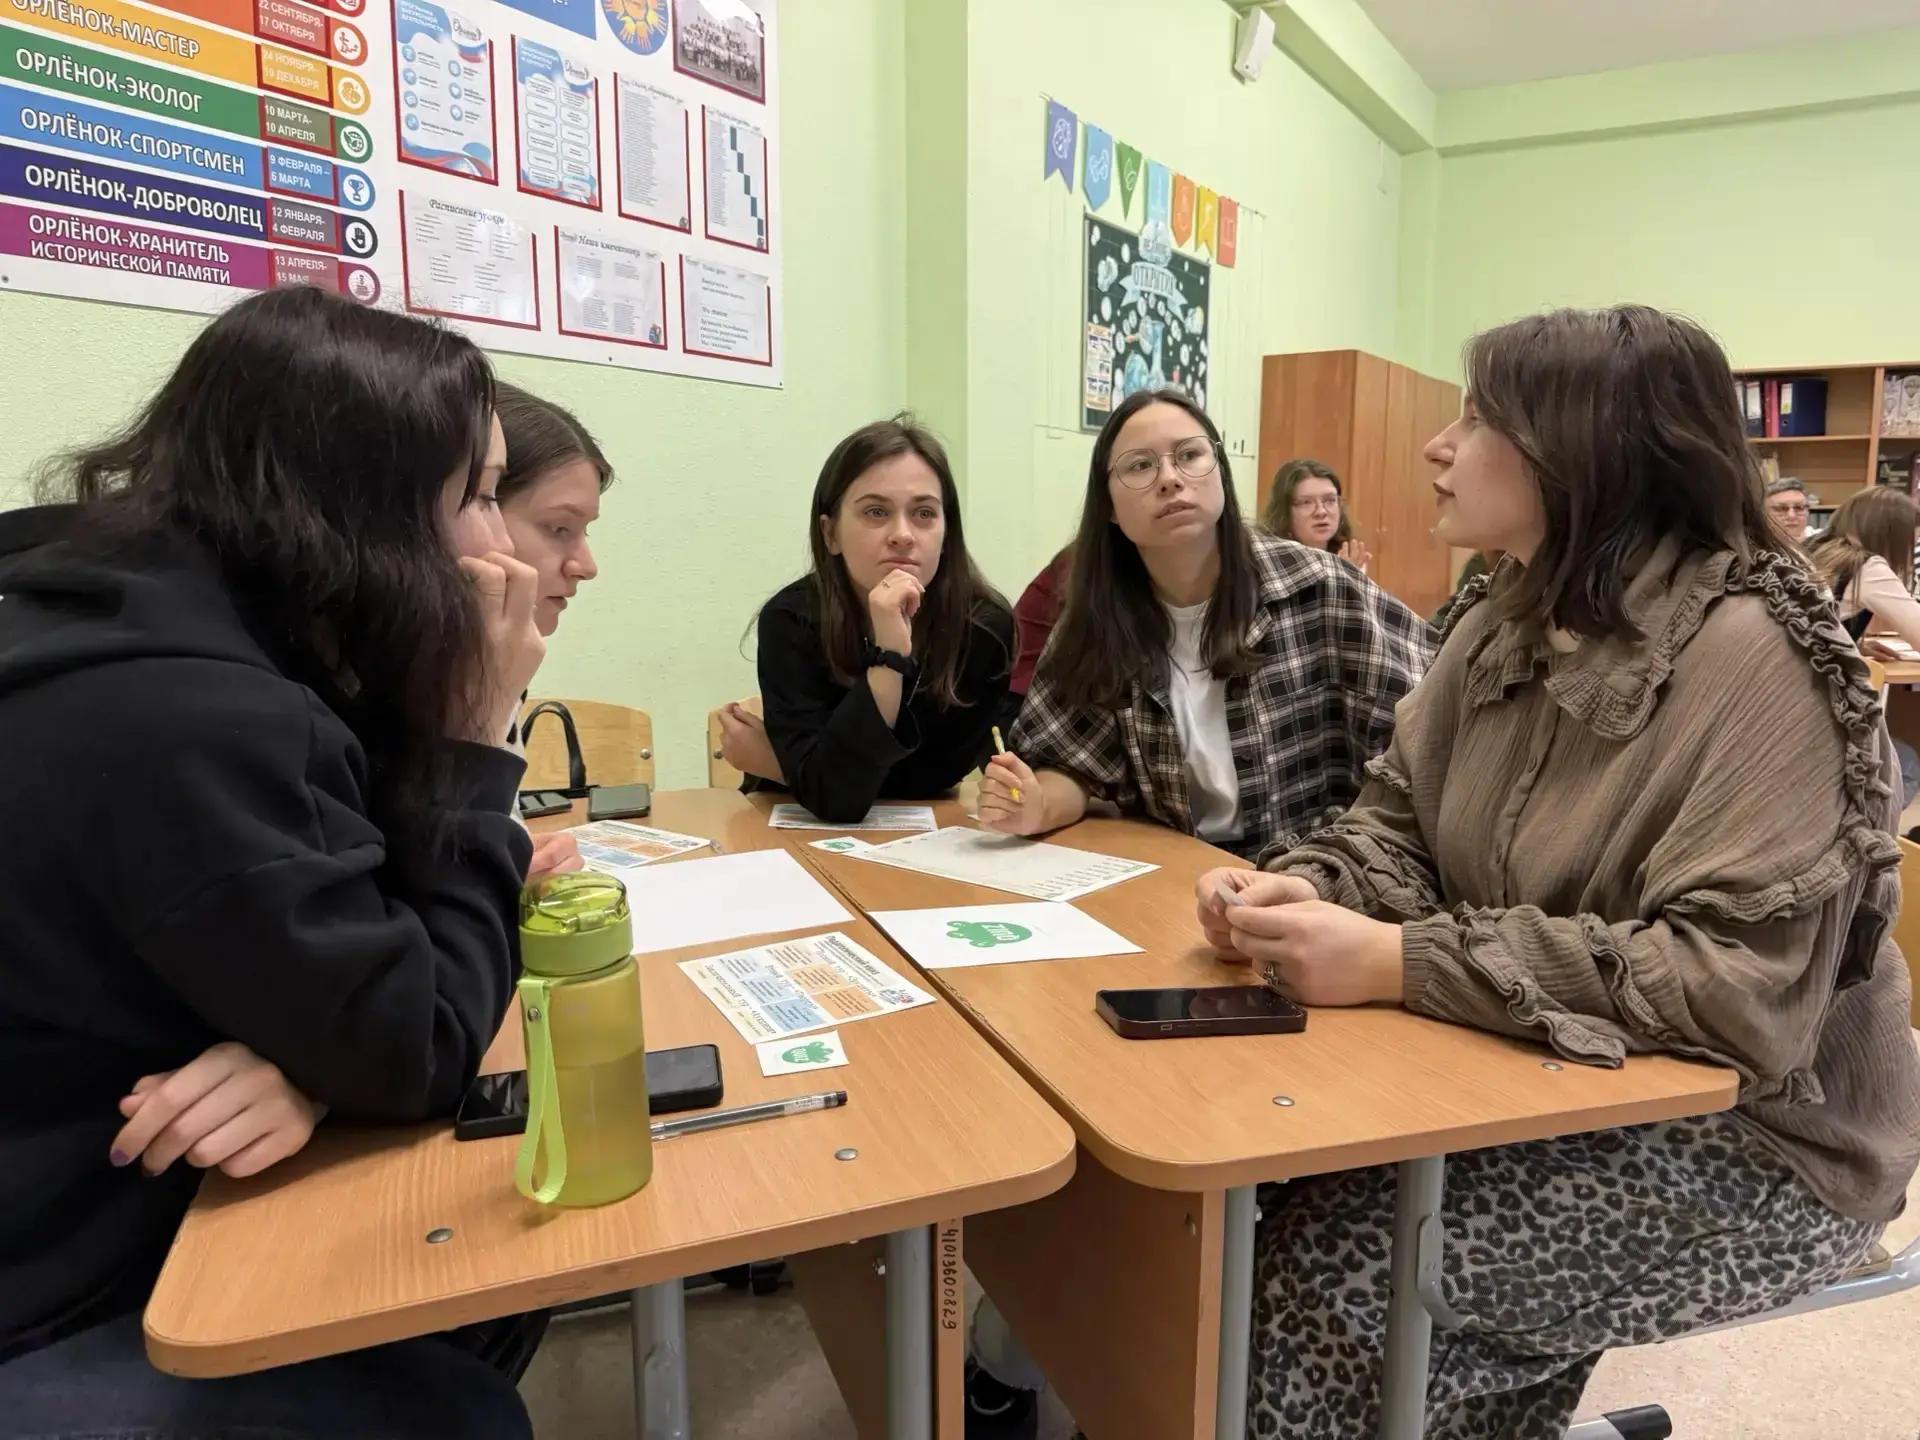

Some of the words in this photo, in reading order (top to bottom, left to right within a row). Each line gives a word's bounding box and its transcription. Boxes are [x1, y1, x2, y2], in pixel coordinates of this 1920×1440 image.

[260, 14, 269, 27] 17
[271, 19, 315, 42] ОКТЯБРЯ
[16, 48, 203, 113] ОРЛЁНОК-ЭКОЛОГ
[276, 69, 319, 91] ДЕКАБРЯ
[264, 105, 275, 116] 10
[20, 107, 245, 176] ОРЛЁНОК-СПОРТСМЕН
[266, 122, 276, 132] 10
[278, 125, 316, 143] АПРЕЛЯ
[270, 155, 276, 164] 9
[278, 157, 322, 175] ФЕВРАЛЯ
[271, 171, 277, 182] 6
[278, 172, 311, 189] МАРТА
[25, 165, 264, 232] ОРЛЁНОК-ДОБРОВОЛЕЦ
[272, 206, 282, 217] 12
[29, 214, 230, 264] ОРЛЁНОК-ХРАНИТЕЛЬ
[272, 223, 278, 232] 4
[280, 224, 325, 242] ФЕВРАЛЯ
[31, 240, 163, 275] ИСТОРИЧЕСКОЙ
[166, 261, 231, 285] ПАМЯТИ
[275, 255, 285, 266] 13
[277, 272, 287, 282] 15
[289, 273, 309, 285] МАЯ
